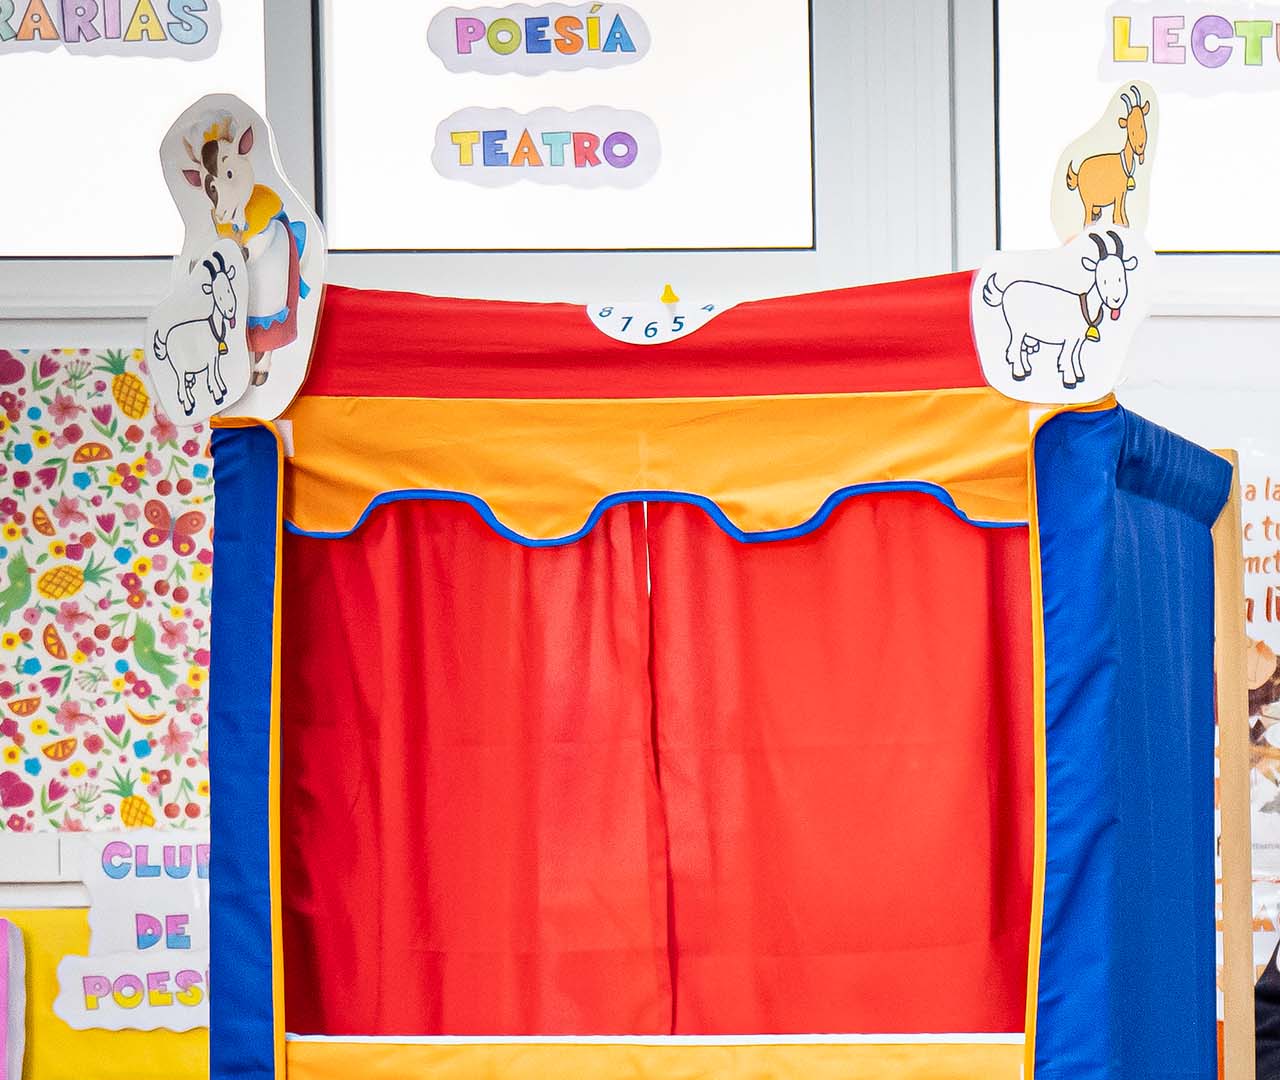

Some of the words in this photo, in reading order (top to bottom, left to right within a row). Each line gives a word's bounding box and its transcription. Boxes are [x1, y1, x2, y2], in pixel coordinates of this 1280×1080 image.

[455, 4, 637, 55] POESÍA
[450, 128, 638, 169] TEATRO
[621, 316, 633, 332] 7
[644, 321, 658, 338] 6
[671, 316, 685, 332] 5
[136, 914, 191, 949] DE
[83, 969, 209, 1011] POES
